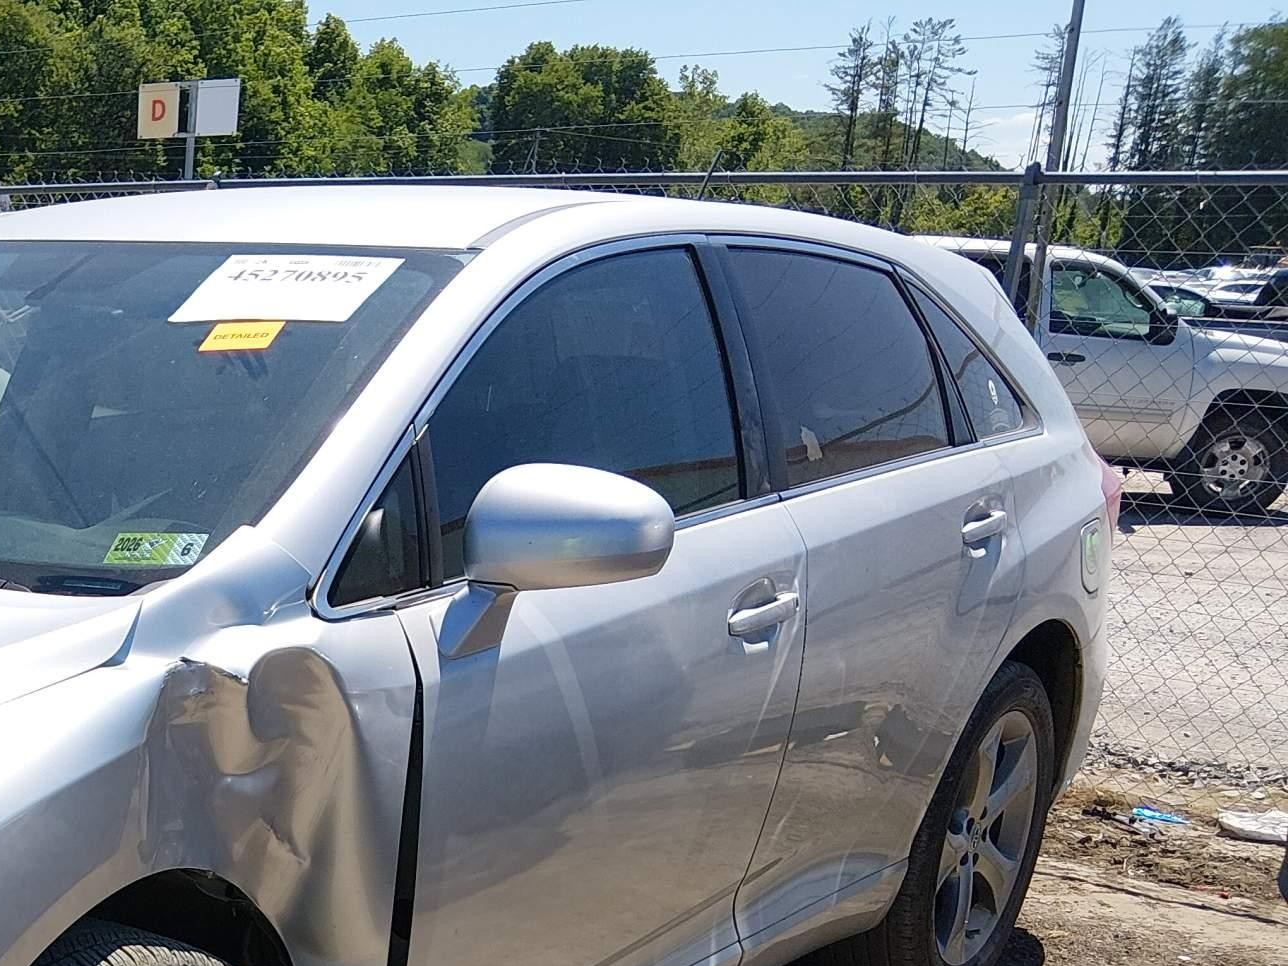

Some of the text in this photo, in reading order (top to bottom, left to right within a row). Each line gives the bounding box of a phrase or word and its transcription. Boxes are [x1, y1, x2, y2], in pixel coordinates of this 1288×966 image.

[151, 99, 165, 121] D
[228, 269, 368, 283] 45270895
[213, 332, 270, 340] DETAILED
[113, 537, 143, 552] 2026
[180, 542, 194, 557] 6
